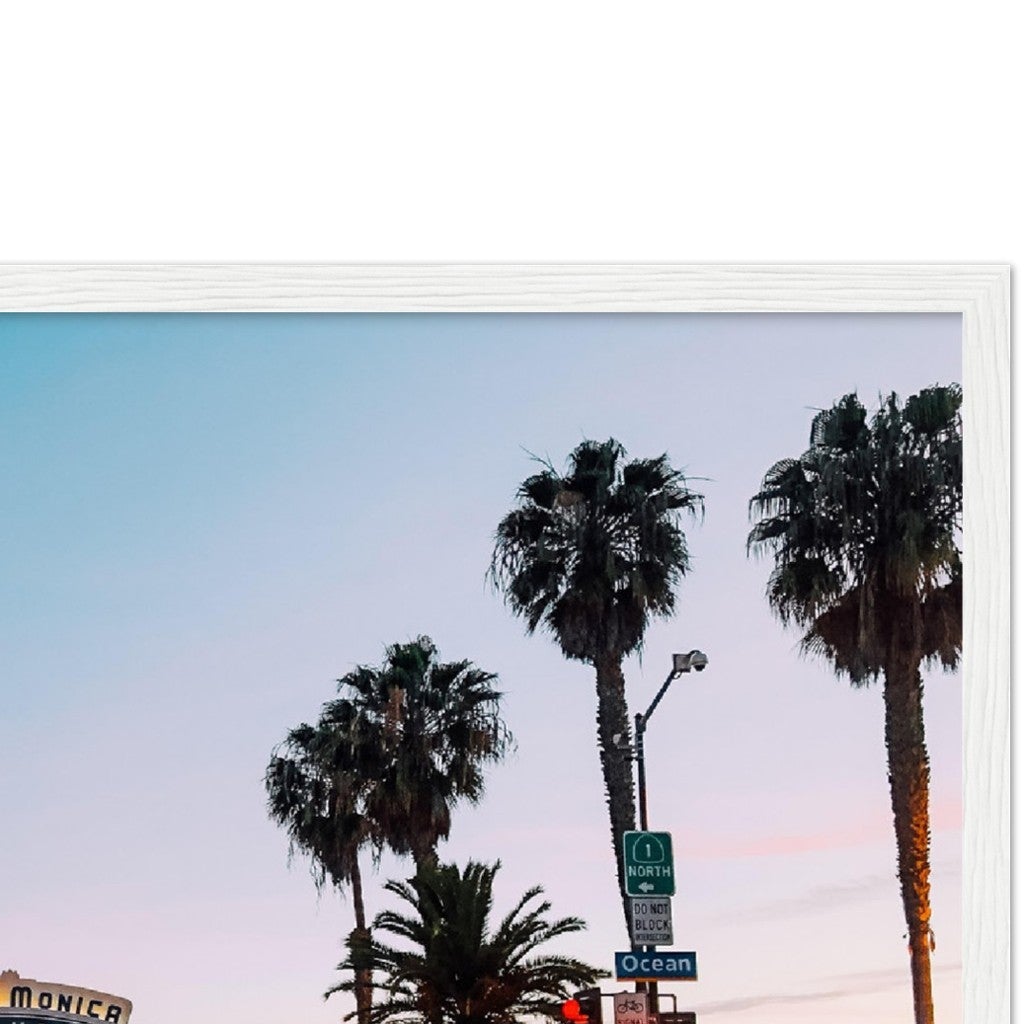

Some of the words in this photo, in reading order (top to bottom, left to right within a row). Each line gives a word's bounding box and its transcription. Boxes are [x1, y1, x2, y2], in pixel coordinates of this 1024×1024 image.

[645, 843, 651, 858] 1
[628, 865, 671, 877] NORTH
[634, 903, 647, 914] DO
[650, 903, 669, 914] NOT
[635, 919, 670, 930] BLOCK
[621, 955, 691, 972] Ocean
[10, 986, 123, 1023] MONICA
